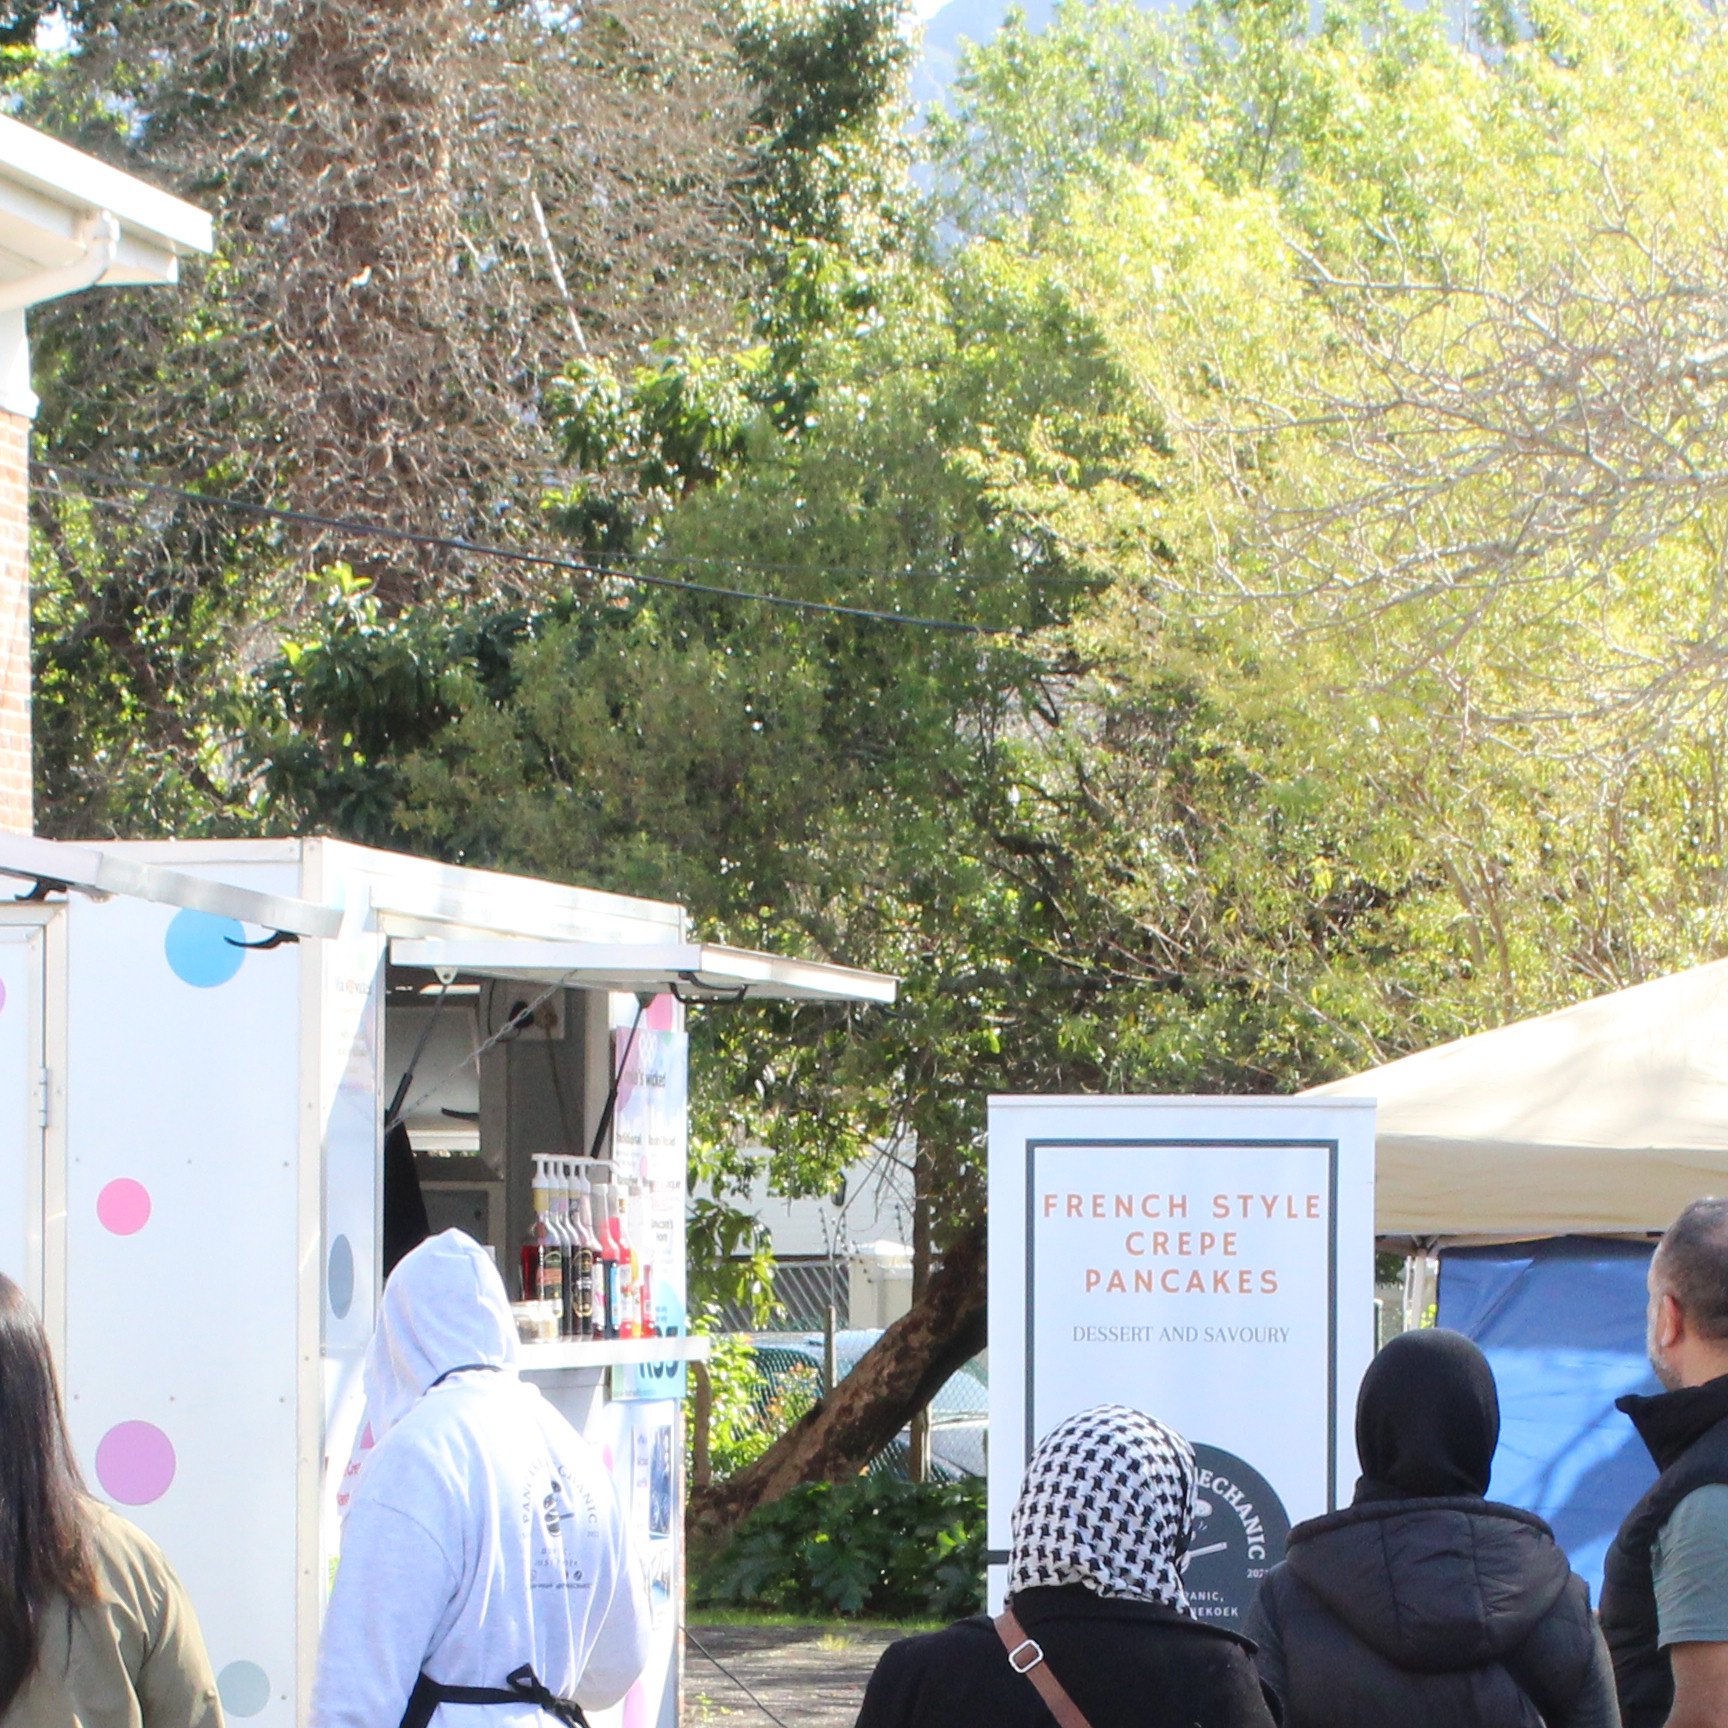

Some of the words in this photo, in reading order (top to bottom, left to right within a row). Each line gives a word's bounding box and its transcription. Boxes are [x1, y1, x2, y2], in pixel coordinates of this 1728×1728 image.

[1043, 1194, 1188, 1219] FRENCH
[1212, 1194, 1320, 1219] STYLE
[1125, 1231, 1238, 1256] CREPE
[1085, 1269, 1279, 1294] PANCAKES
[1072, 1326, 1154, 1343] DESSERT
[1159, 1326, 1199, 1343] AND
[1203, 1326, 1290, 1344] SAVOURY
